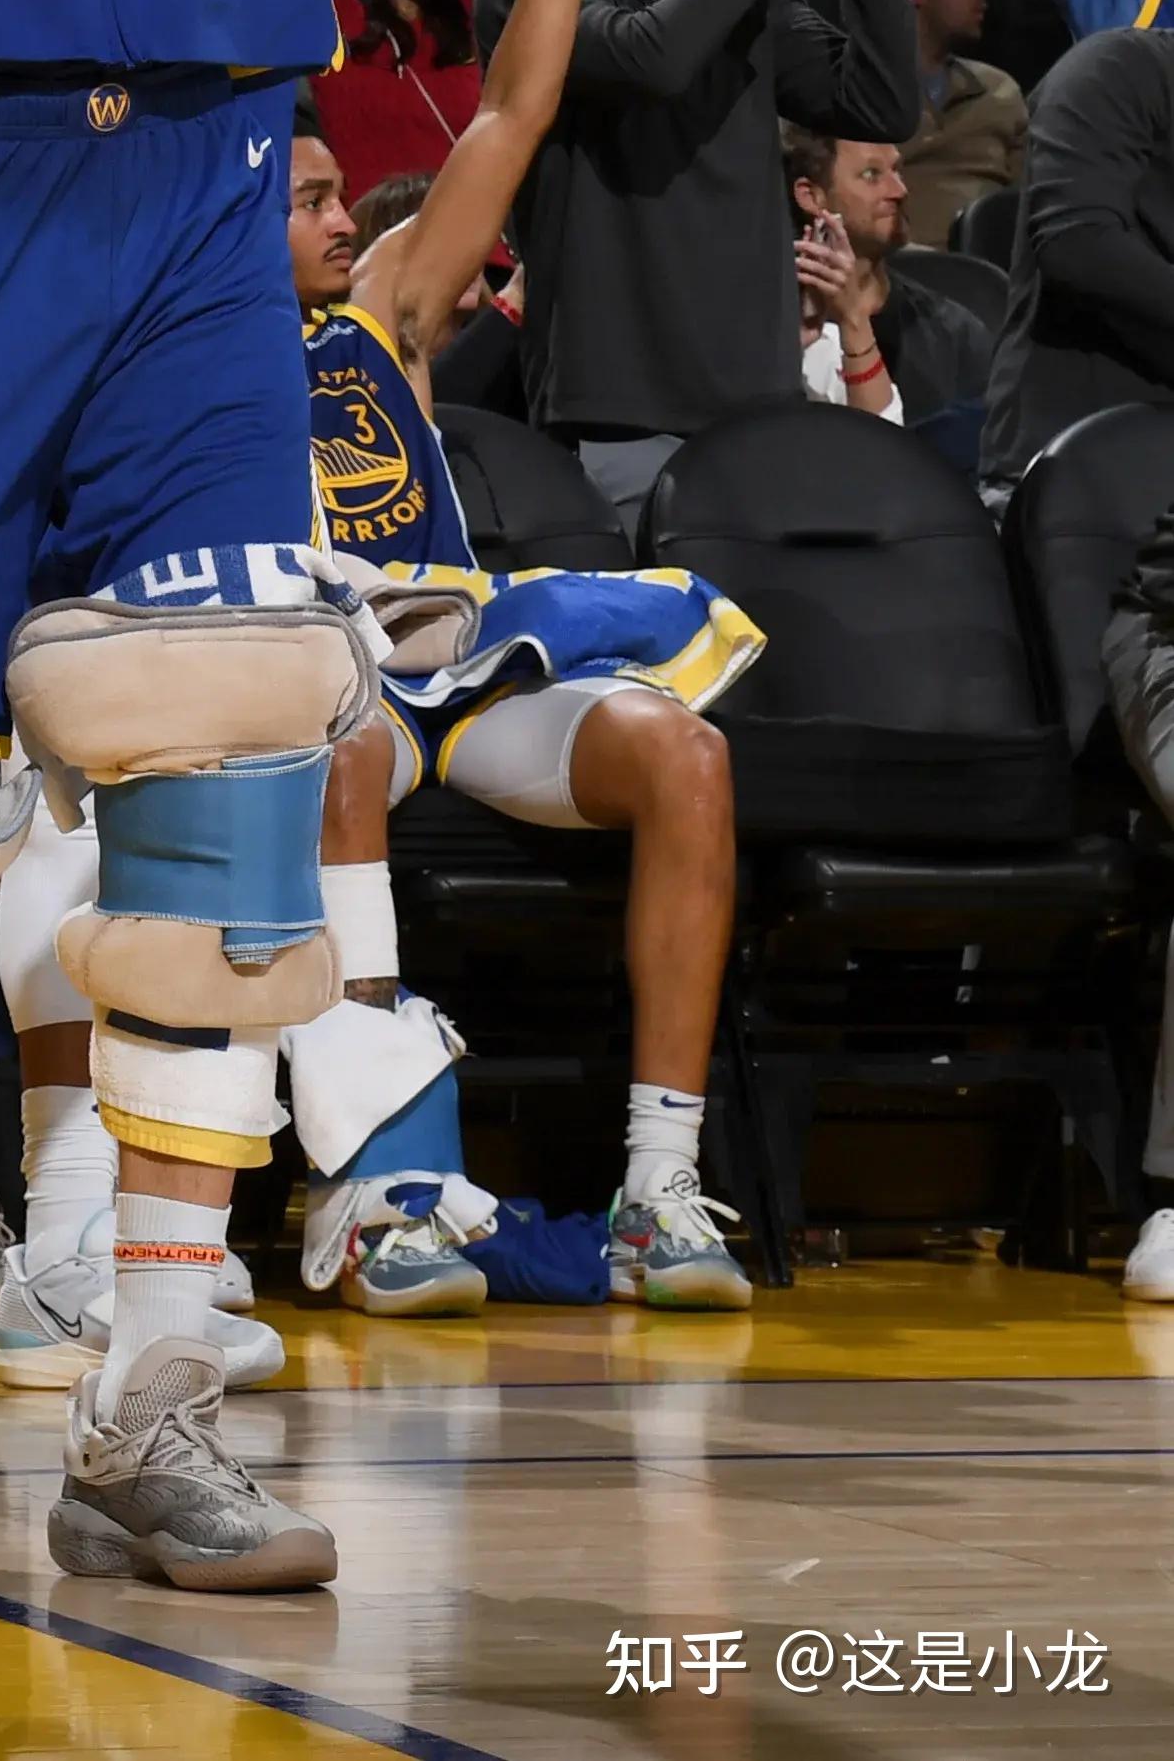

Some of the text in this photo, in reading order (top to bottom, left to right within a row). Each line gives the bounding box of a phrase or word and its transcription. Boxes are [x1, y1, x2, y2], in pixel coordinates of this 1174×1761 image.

[89, 94, 128, 127] W
[344, 404, 376, 445] 3
[332, 477, 426, 543] RRIORS
[114, 1245, 208, 1261] AUTHENT
